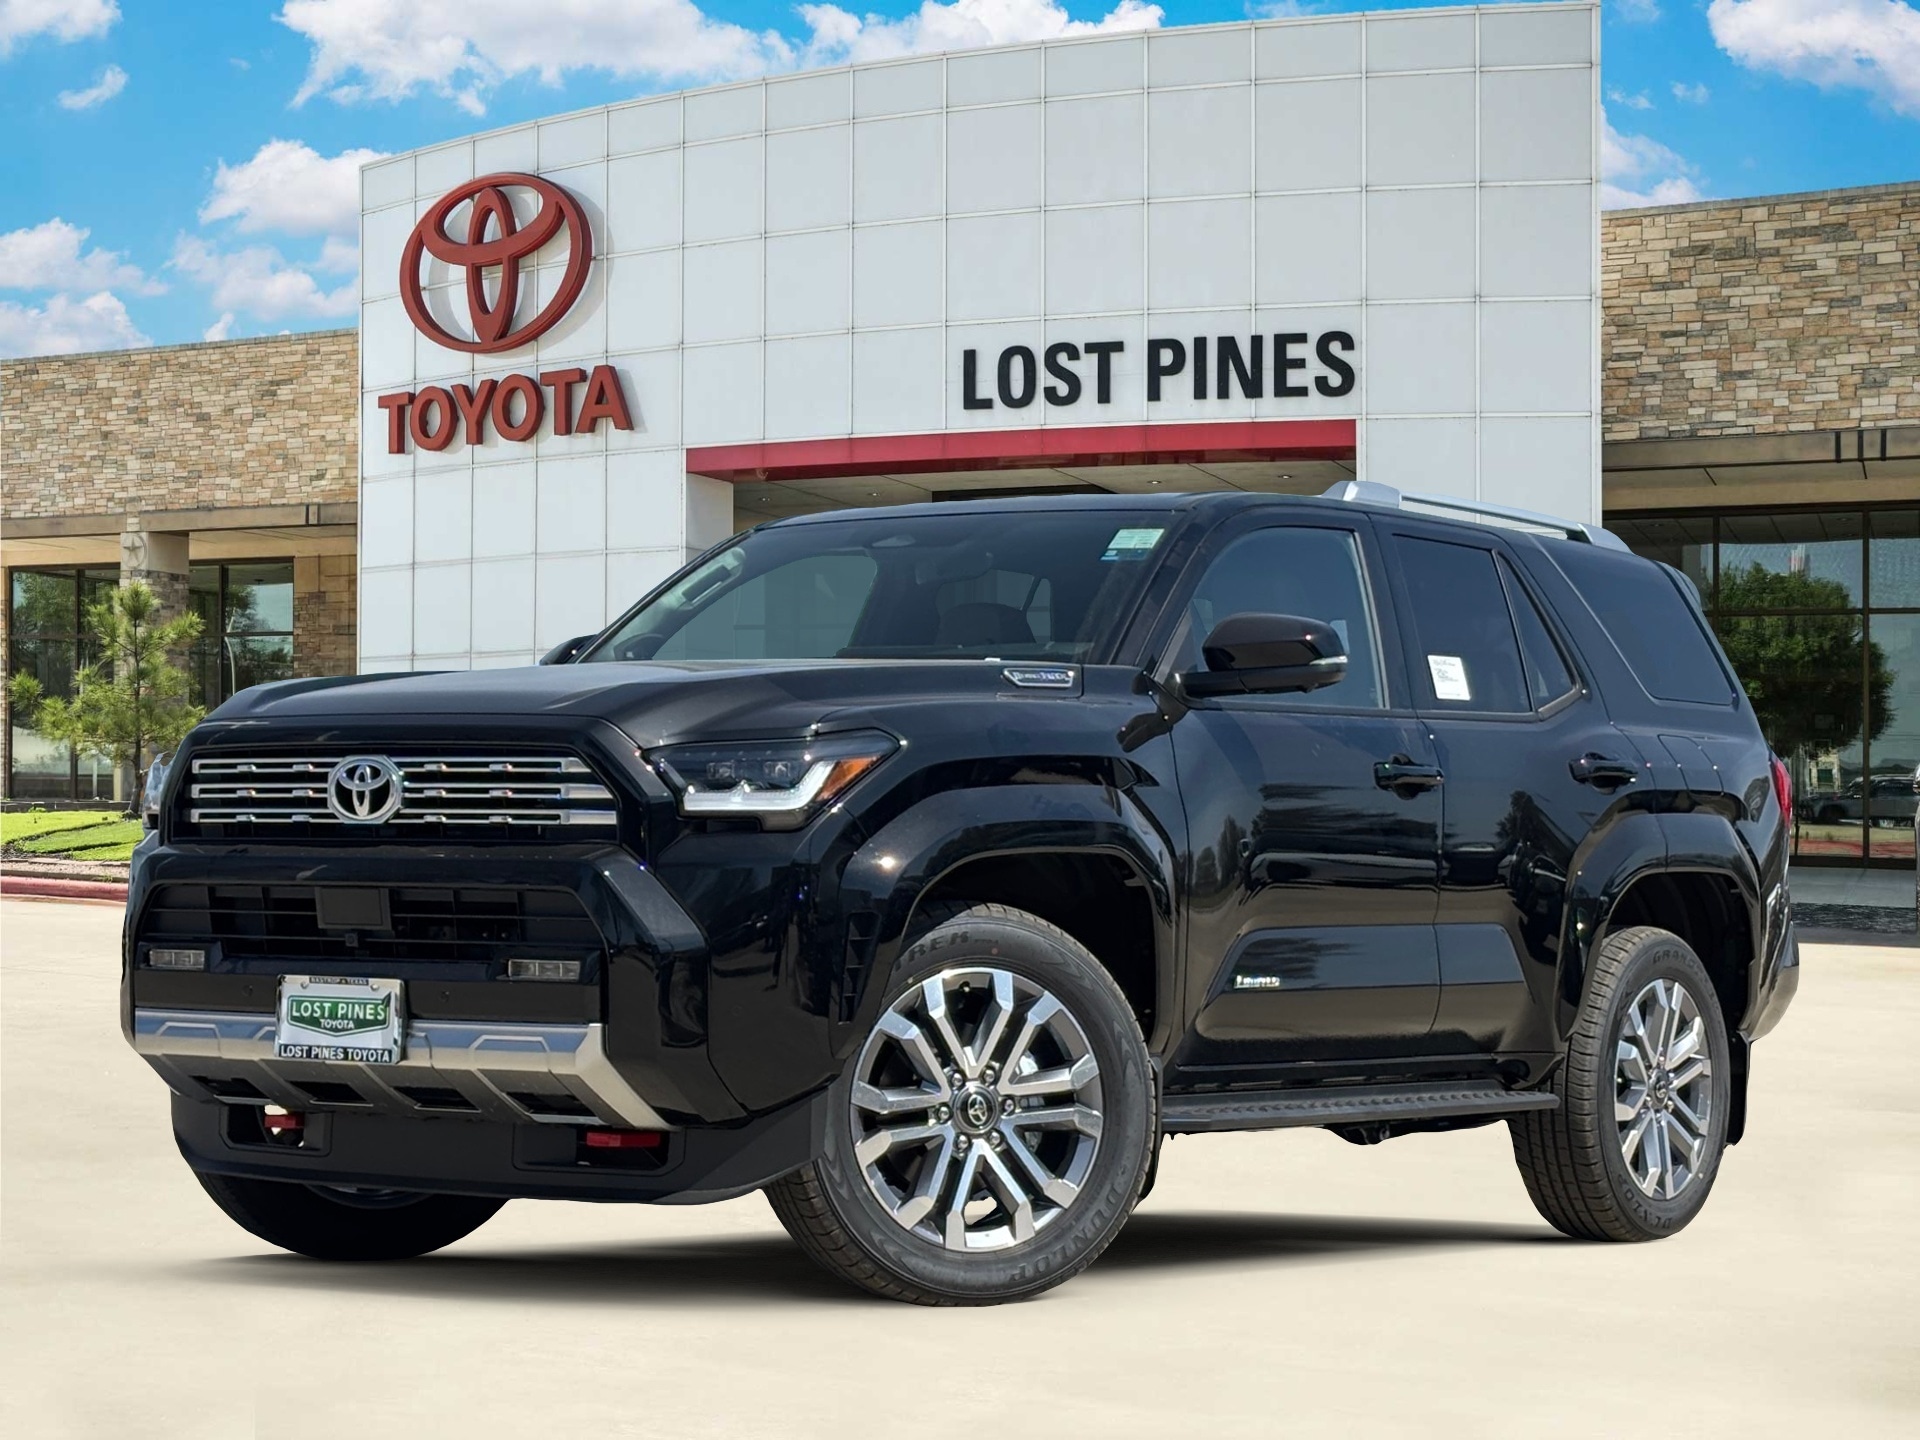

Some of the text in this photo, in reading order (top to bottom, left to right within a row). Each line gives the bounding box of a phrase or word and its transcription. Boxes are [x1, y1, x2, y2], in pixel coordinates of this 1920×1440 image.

[963, 330, 1356, 410] LOST PINES
[378, 364, 634, 454] TOYOTA
[291, 1001, 386, 1020] LOST PINES
[319, 1018, 355, 1030] TOYOTA
[280, 1045, 390, 1063] LOST PINES TOYOTA
